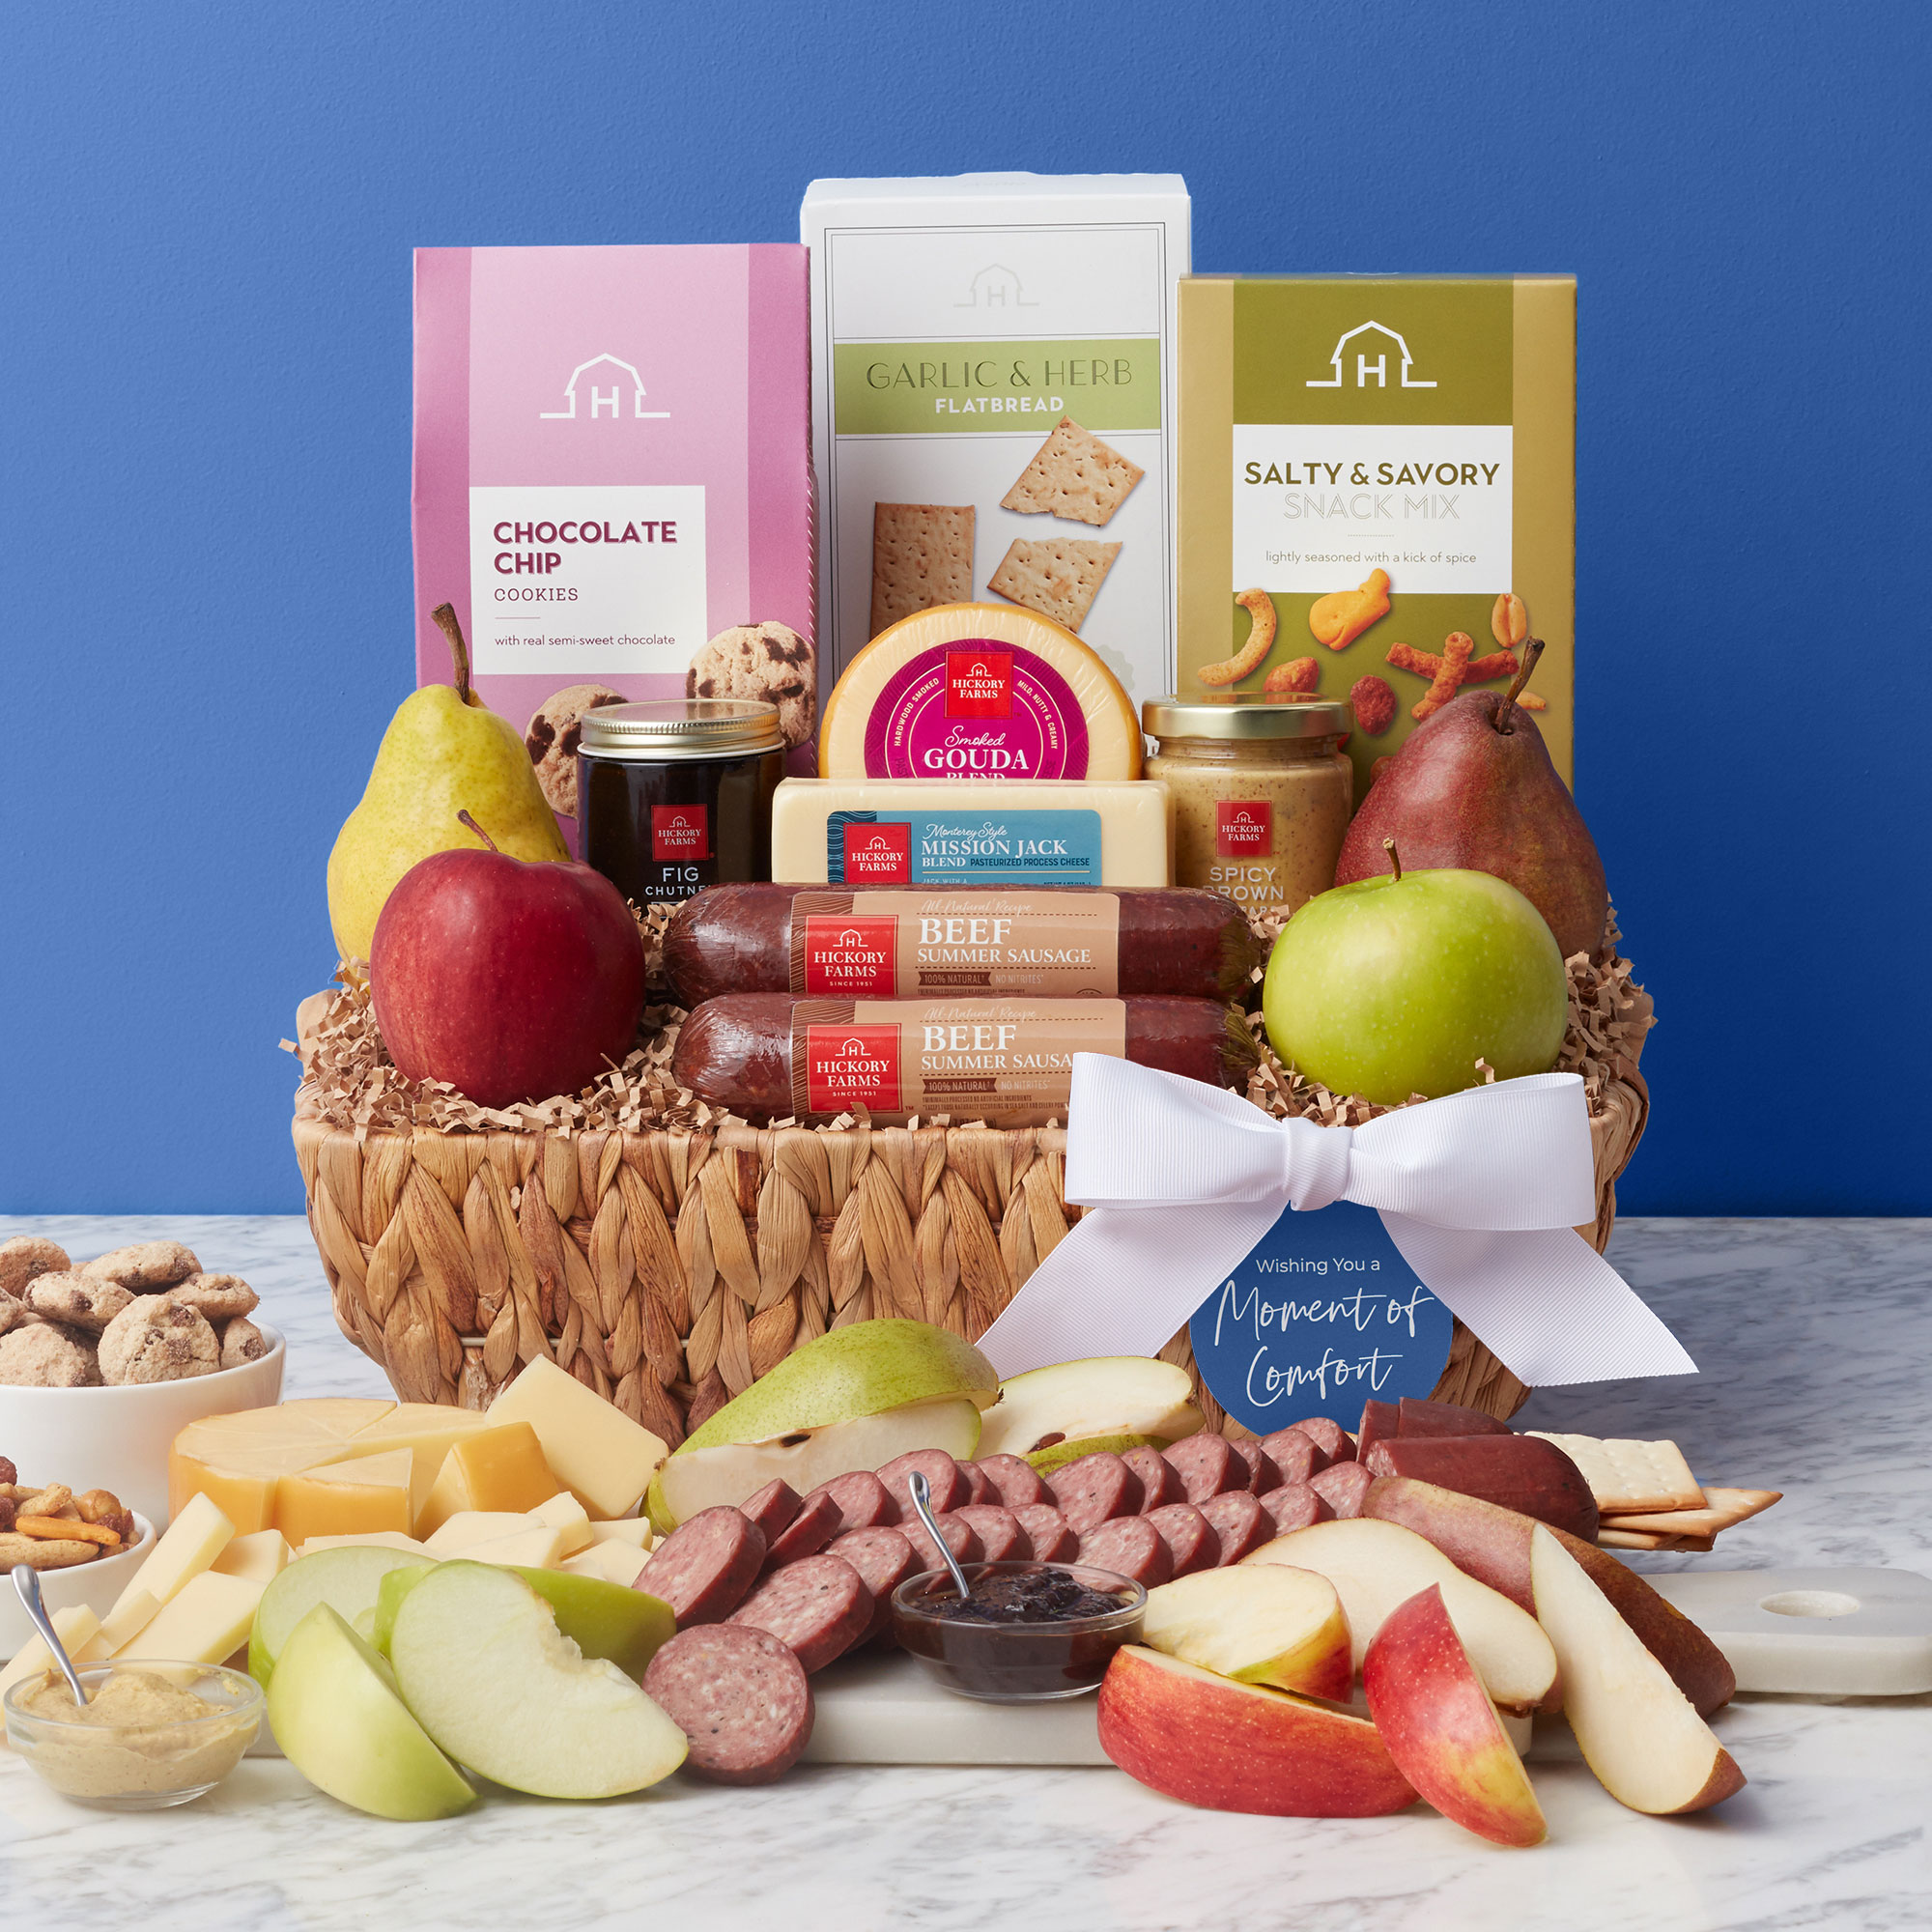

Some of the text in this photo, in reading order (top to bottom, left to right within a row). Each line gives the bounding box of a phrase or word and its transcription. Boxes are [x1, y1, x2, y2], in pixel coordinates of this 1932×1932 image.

[866, 358, 1133, 390] GARLIC & HERB
[1357, 354, 1386, 387] H
[591, 385, 619, 419] H
[935, 396, 1065, 413] FLATBREAD
[1243, 462, 1500, 485] SALTY & SAVORY
[1282, 493, 1461, 520] SNACK MIX
[493, 521, 678, 545] CHOCOLATE
[494, 552, 562, 575] CHIP
[1264, 550, 1477, 565] lightly seasoned with a kick of spice
[494, 587, 580, 602] COOKIES
[494, 632, 676, 646] with real semi-sweet chocolate
[952, 679, 1006, 690] HICKORY
[959, 690, 999, 699] FARMS
[894, 701, 914, 747] HARDWOOD
[911, 677, 940, 702] SMOKED
[1032, 694, 1049, 714] NUTTY
[1047, 722, 1059, 750] CREAMY
[944, 725, 1007, 748] Smoked
[923, 748, 1030, 770] GOUDA
[658, 829, 701, 838] HICKORY
[923, 821, 1008, 841] Monterey Style
[1221, 825, 1265, 834] HICKORY
[851, 852, 903, 862] HICKORY
[922, 839, 1068, 859] MISSION JACK
[859, 863, 897, 871] FARMS
[922, 857, 1090, 867] BLEND PASTEURIZED PROCESS CHEESE
[662, 867, 699, 883] FIG
[1208, 867, 1276, 882] SPICY
[644, 884, 705, 896] CHUTNE
[1203, 885, 1284, 901] ROWN
[919, 918, 1012, 946] BEEF
[814, 951, 887, 965] HICKORY
[918, 948, 1092, 964] SUMMER SAUSAGE
[825, 965, 877, 978] FARMS
[923, 974, 947, 984] 100%
[995, 974, 1007, 984] NO
[922, 1024, 1017, 1052] BEEF
[816, 1060, 891, 1074] HICKORY
[921, 1053, 1073, 1070] SUMMER SAUSA
[827, 1074, 881, 1088] FARMS
[928, 1080, 952, 1092] 100%
[1001, 1080, 1012, 1091] NO
[1256, 1258, 1381, 1275] Wishing You a
[1214, 1279, 1435, 1347] Moment of
[1246, 1345, 1404, 1407] Comfort
